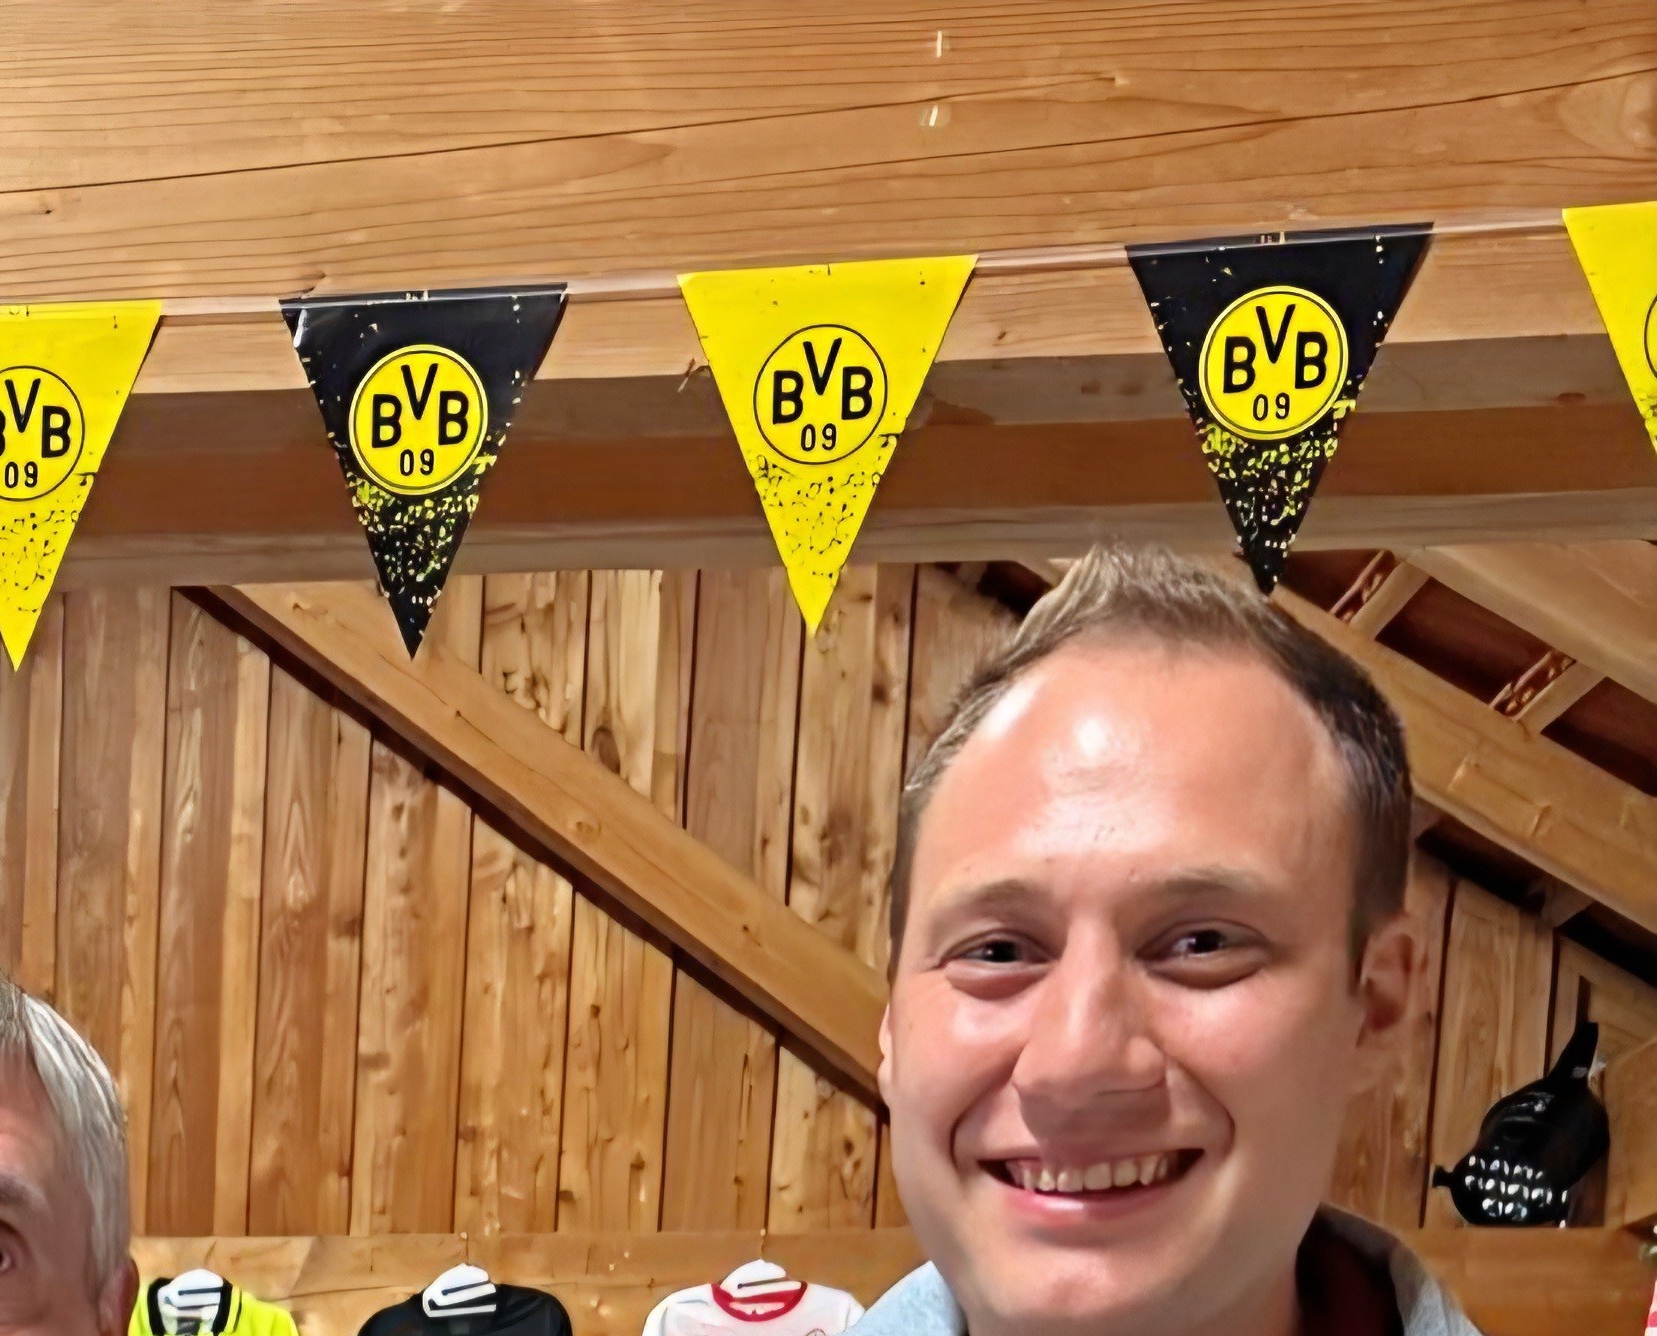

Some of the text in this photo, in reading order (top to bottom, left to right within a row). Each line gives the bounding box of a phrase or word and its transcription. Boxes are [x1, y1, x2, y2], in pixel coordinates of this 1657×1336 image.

[1223, 304, 1327, 393] BVB
[773, 338, 873, 424] BVB
[372, 364, 468, 448] BVB
[1253, 393, 1289, 421] 09
[801, 423, 836, 451] 09
[5, 462, 37, 488] 09
[400, 449, 434, 476] 09
